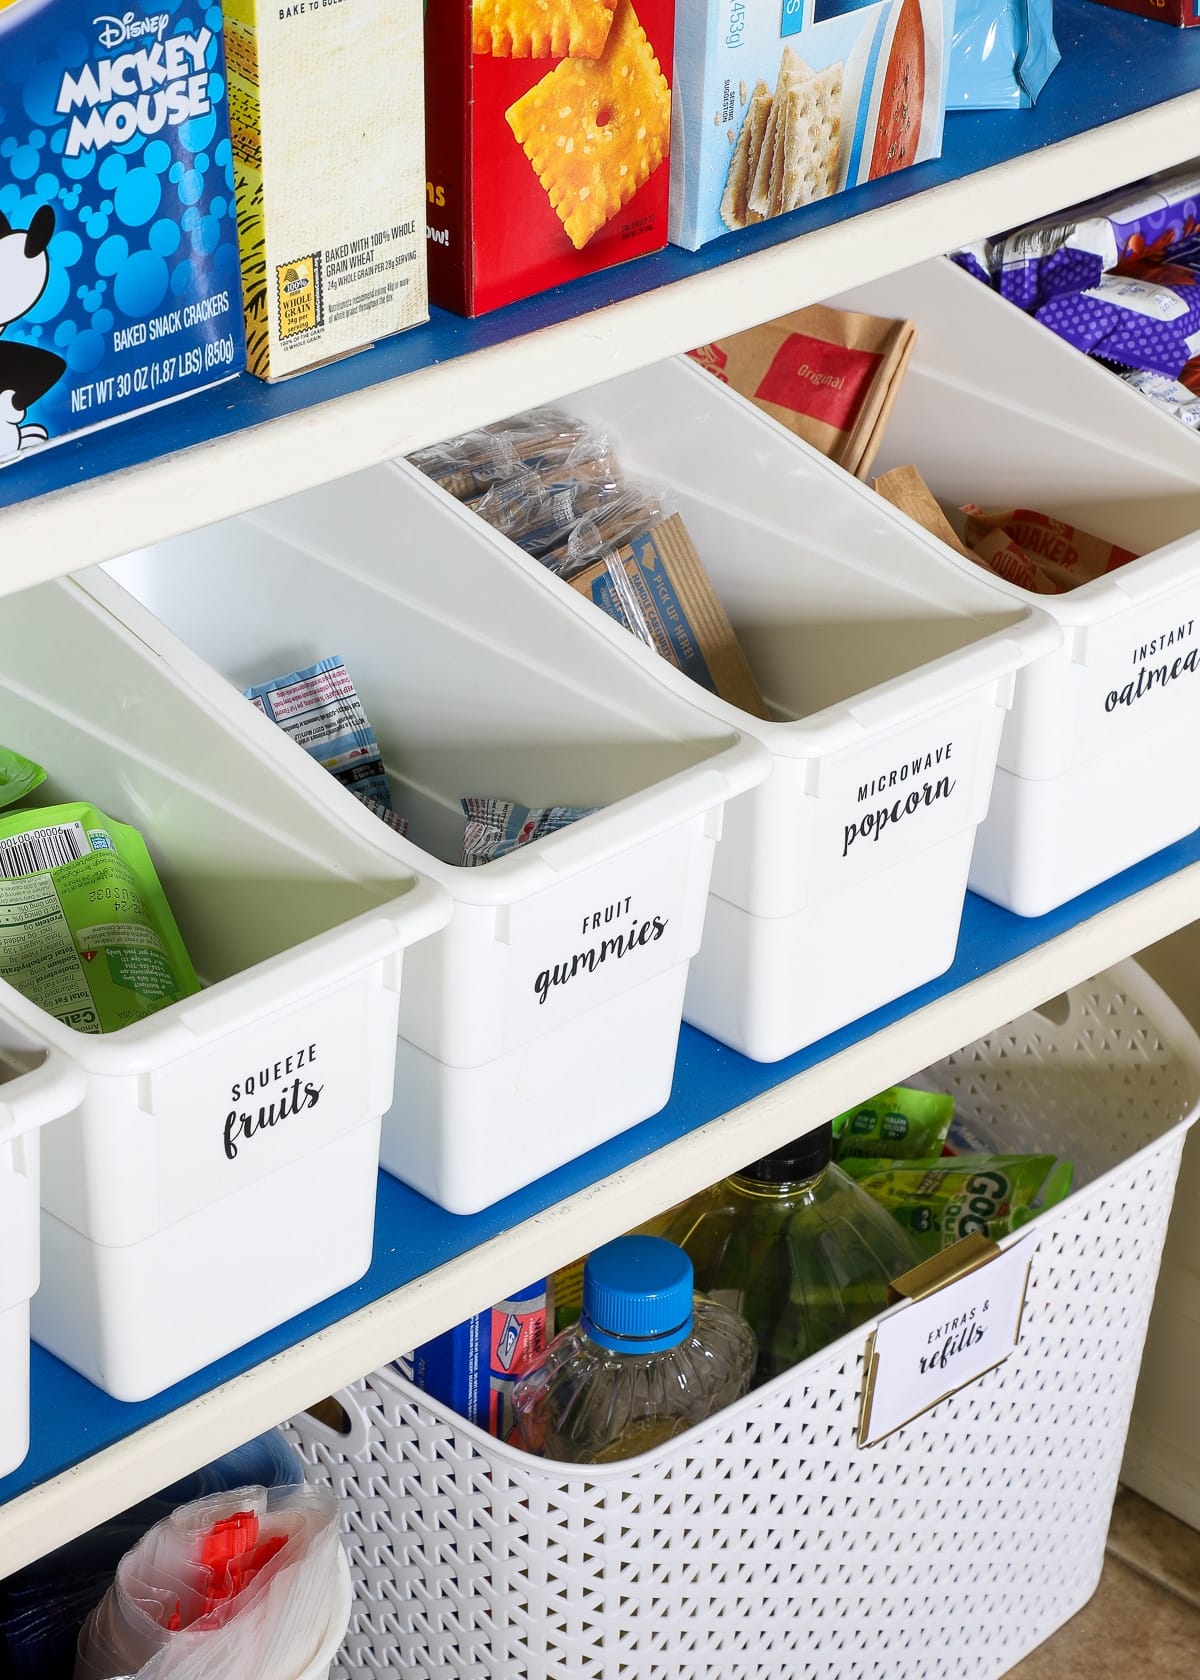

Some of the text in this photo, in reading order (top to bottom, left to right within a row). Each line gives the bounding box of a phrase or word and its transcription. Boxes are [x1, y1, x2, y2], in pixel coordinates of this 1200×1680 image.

[279, 3, 305, 20] BAKE
[309, 1, 319, 11] TO
[726, 0, 745, 49] 453g)
[56, 27, 212, 113] MICKEY
[64, 72, 210, 156] MOUSE
[325, 220, 416, 263] BAKED WITH 100% WHOLE
[326, 249, 375, 277] GRAIN WHEAT
[338, 273, 357, 287] WHOLE
[357, 266, 374, 280] GRAIN
[374, 262, 385, 274] PER
[395, 250, 417, 266] SERVING
[113, 291, 230, 352] BAKED SNACK CRACKERS
[282, 293, 312, 310] WHOLE
[284, 303, 311, 319] GRAIN
[288, 321, 309, 333] serving
[71, 334, 234, 413] NET WT 30 OZ (1.87 LBS) (850g)
[797, 364, 846, 390] Original
[631, 573, 652, 609] HANDLE
[648, 610, 673, 658] CAREFULLY
[654, 574, 695, 660] PICK UP HERE!
[1133, 620, 1194, 664] INSTANT
[1105, 648, 1200, 712] oatmea
[857, 742, 953, 802] MICROWAVE
[842, 776, 957, 857] popcorn
[35, 913, 63, 927] Protein
[582, 896, 632, 934] FRUIT
[47, 953, 77, 969] Sodium
[55, 946, 74, 956] Total
[534, 915, 669, 1005] gummies
[35, 963, 80, 983] Cholesterol
[44, 982, 80, 998] Saturated
[54, 996, 68, 1005] Fat
[69, 990, 89, 1001] Total
[231, 1043, 317, 1101] SQUEEZE
[223, 1078, 325, 1160] fruits
[927, 1299, 989, 1344] EXTRAS &
[919, 1322, 988, 1374] refills
